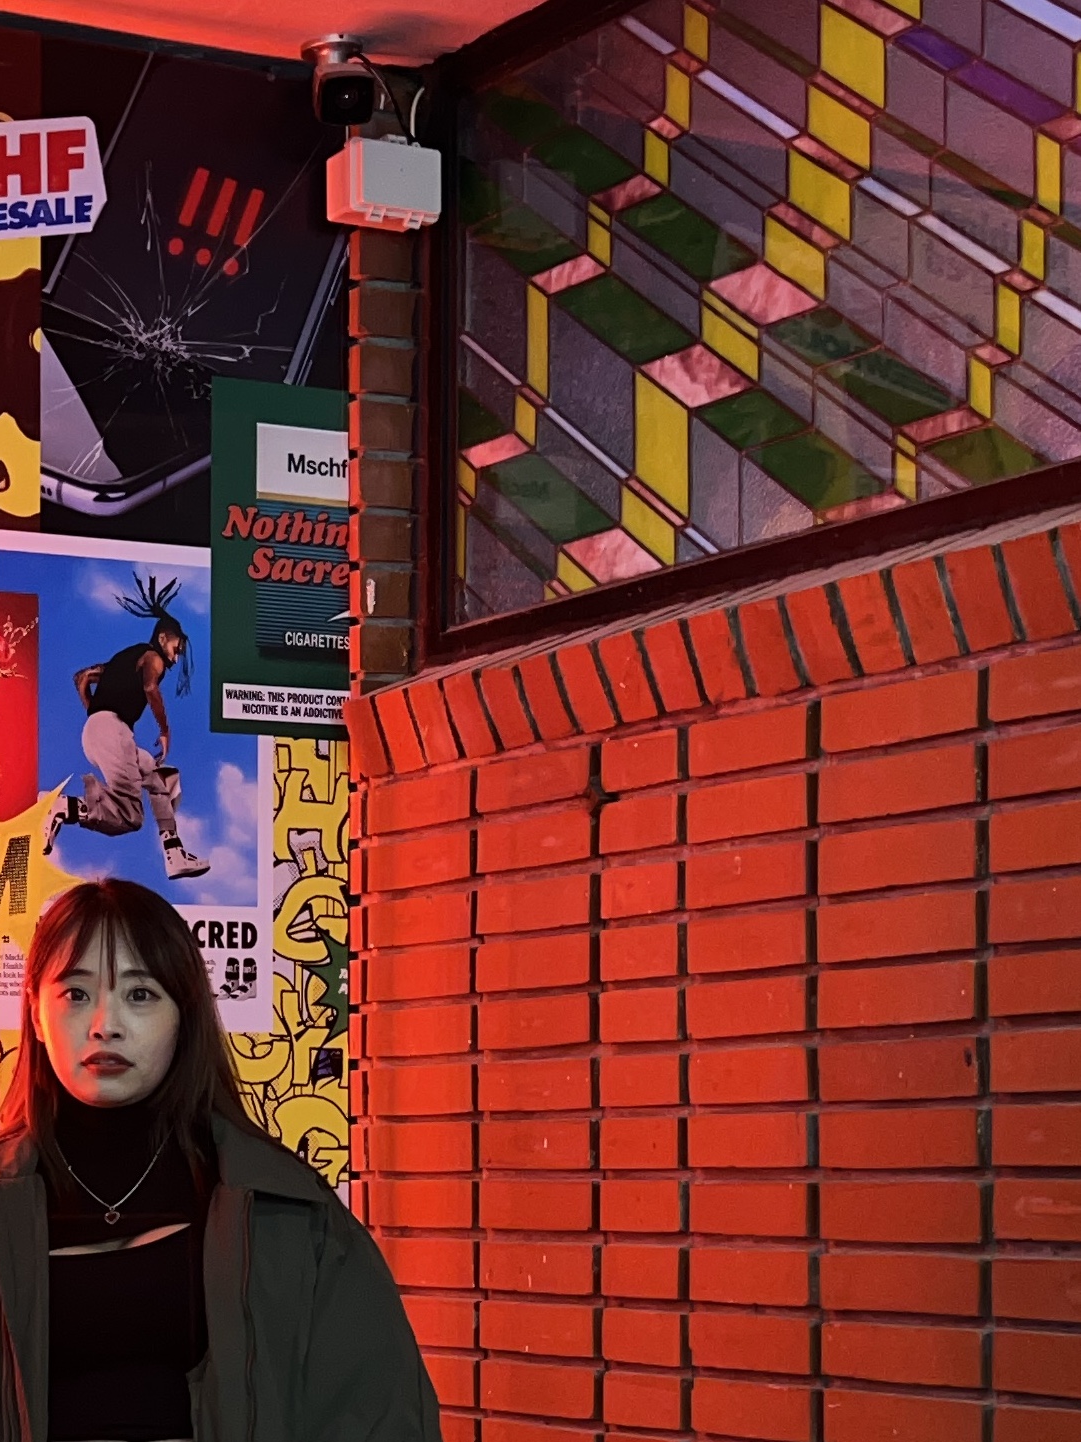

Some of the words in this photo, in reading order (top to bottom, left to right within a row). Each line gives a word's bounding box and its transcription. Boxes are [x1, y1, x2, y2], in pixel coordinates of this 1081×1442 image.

[287, 453, 349, 478] Mschf
[221, 504, 349, 548] Nothin
[247, 547, 349, 586] Sacre
[242, 703, 278, 715] NICOTINE
[281, 706, 288, 715] IS
[290, 706, 301, 717] AN
[268, 691, 285, 703] THIS
[288, 693, 324, 705] PRODUCT
[326, 695, 349, 706] CONT
[192, 920, 258, 949] CRED
